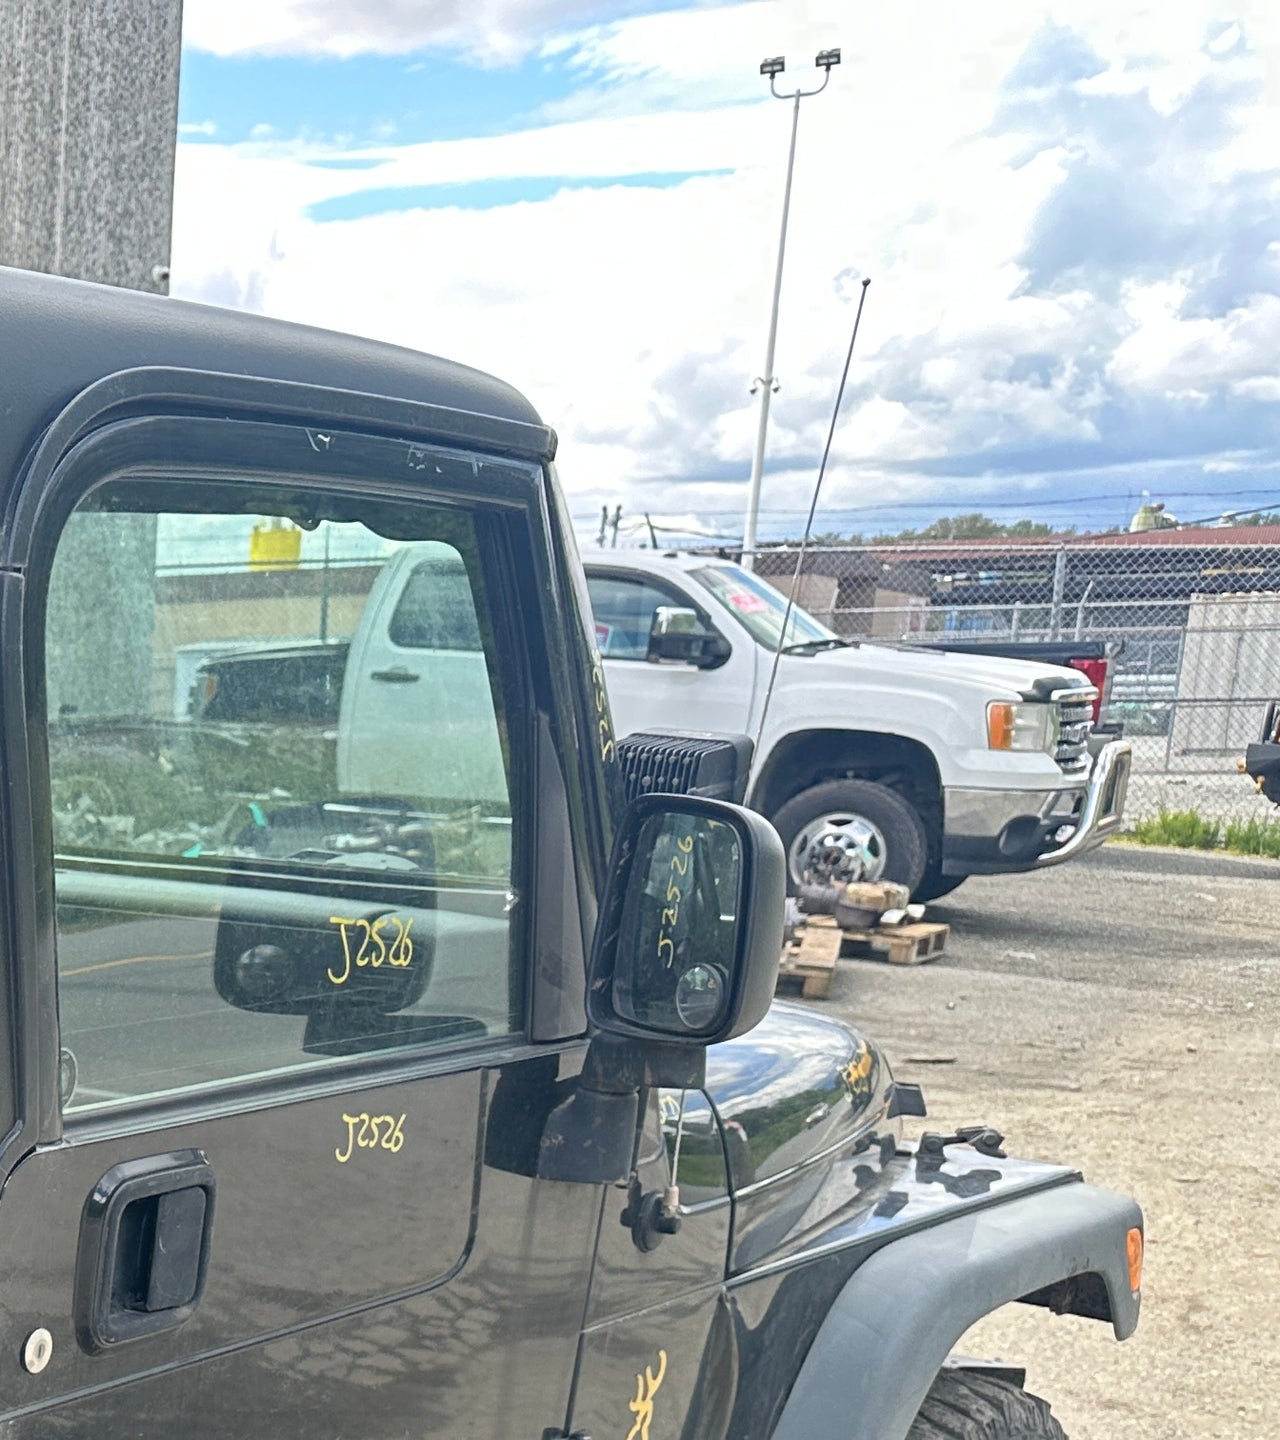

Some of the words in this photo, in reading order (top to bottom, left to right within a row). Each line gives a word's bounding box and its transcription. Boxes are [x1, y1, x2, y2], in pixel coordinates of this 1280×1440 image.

[657, 835, 694, 968] J2526
[327, 916, 414, 984] J2526
[335, 1112, 407, 1163] J2526
